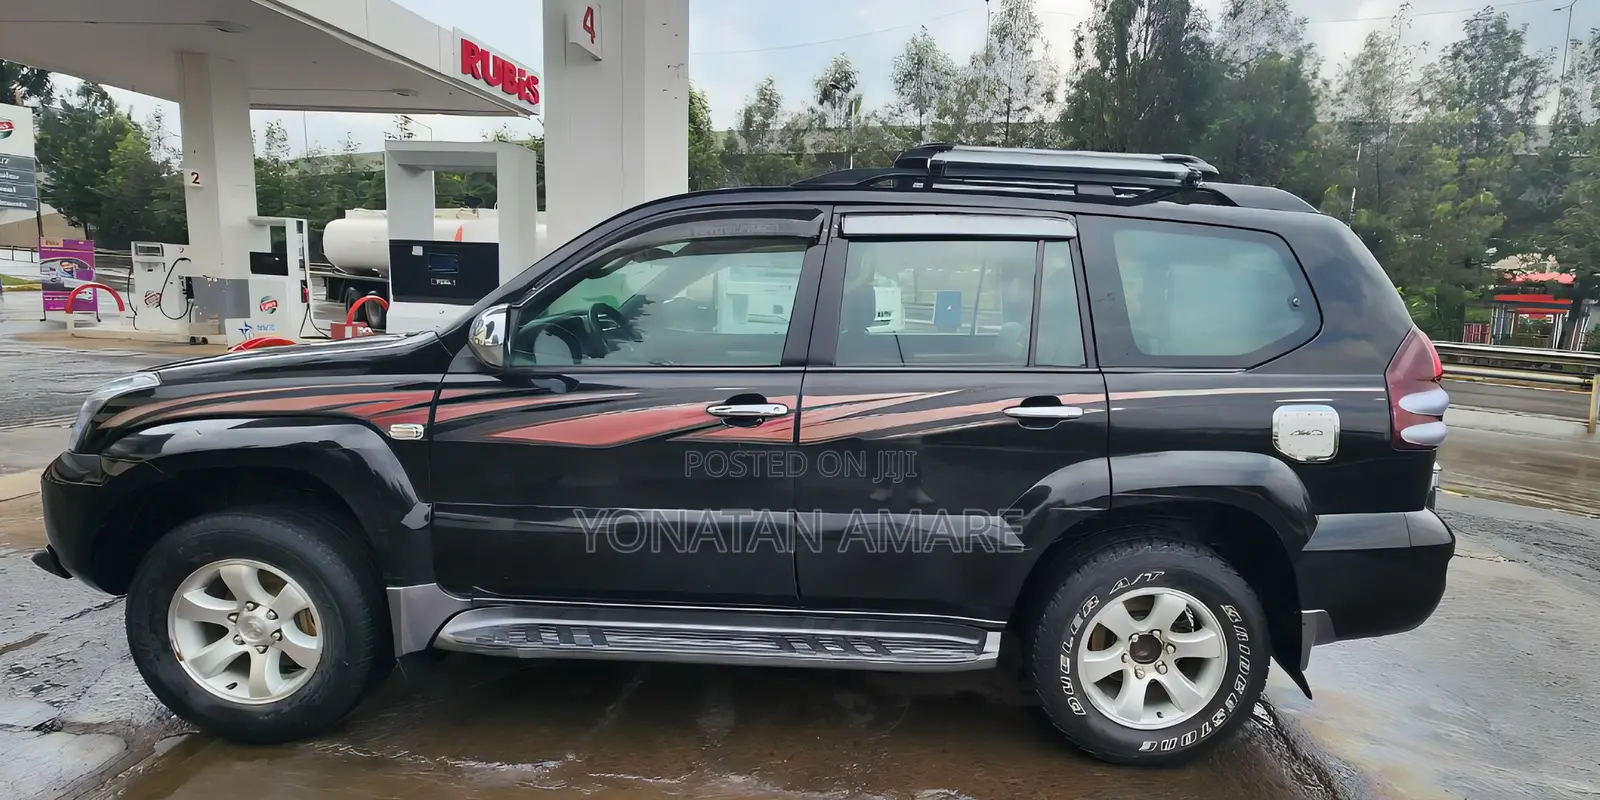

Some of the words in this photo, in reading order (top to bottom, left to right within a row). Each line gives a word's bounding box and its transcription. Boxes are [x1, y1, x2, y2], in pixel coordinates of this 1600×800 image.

[582, 6, 596, 44] 4
[190, 171, 200, 185] 2
[1060, 595, 1100, 716] DUELER
[1109, 571, 1165, 595] A/T
